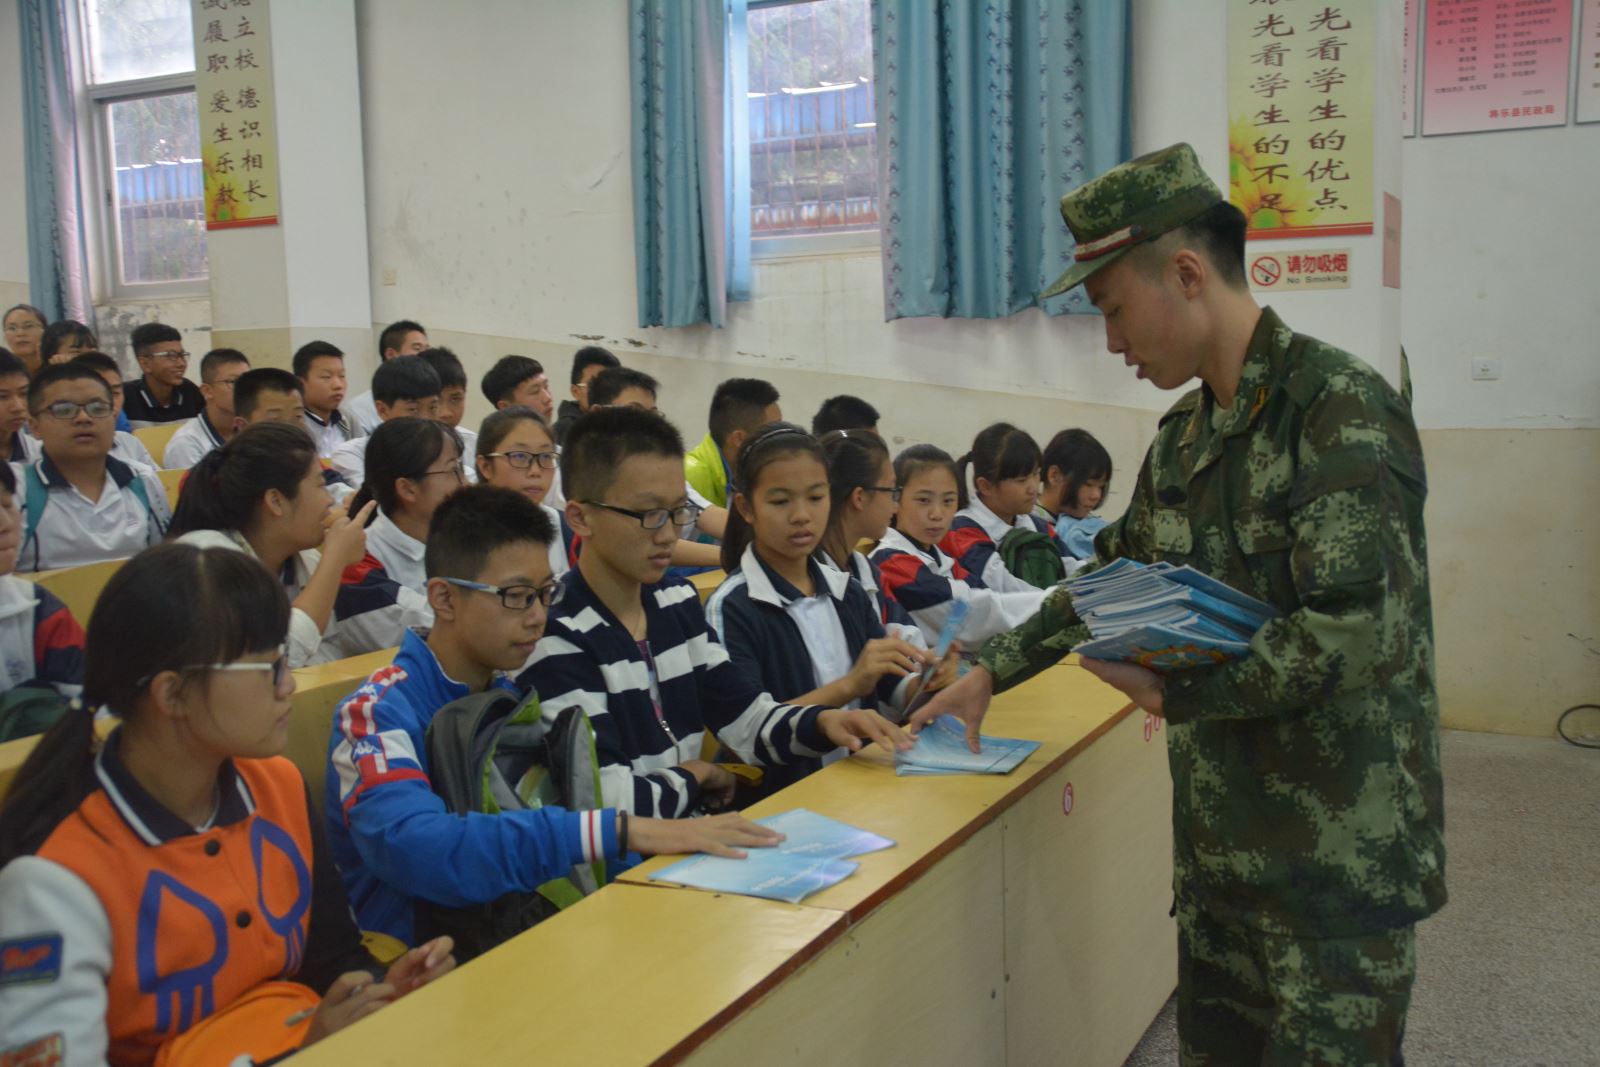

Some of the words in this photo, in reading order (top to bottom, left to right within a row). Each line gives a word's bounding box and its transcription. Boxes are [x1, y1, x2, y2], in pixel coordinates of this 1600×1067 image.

[1248, 0, 1296, 214] 光看学生的不足
[1303, 7, 1351, 212] 光看学生的优点
[1286, 254, 1348, 273] 请勿吸烟
